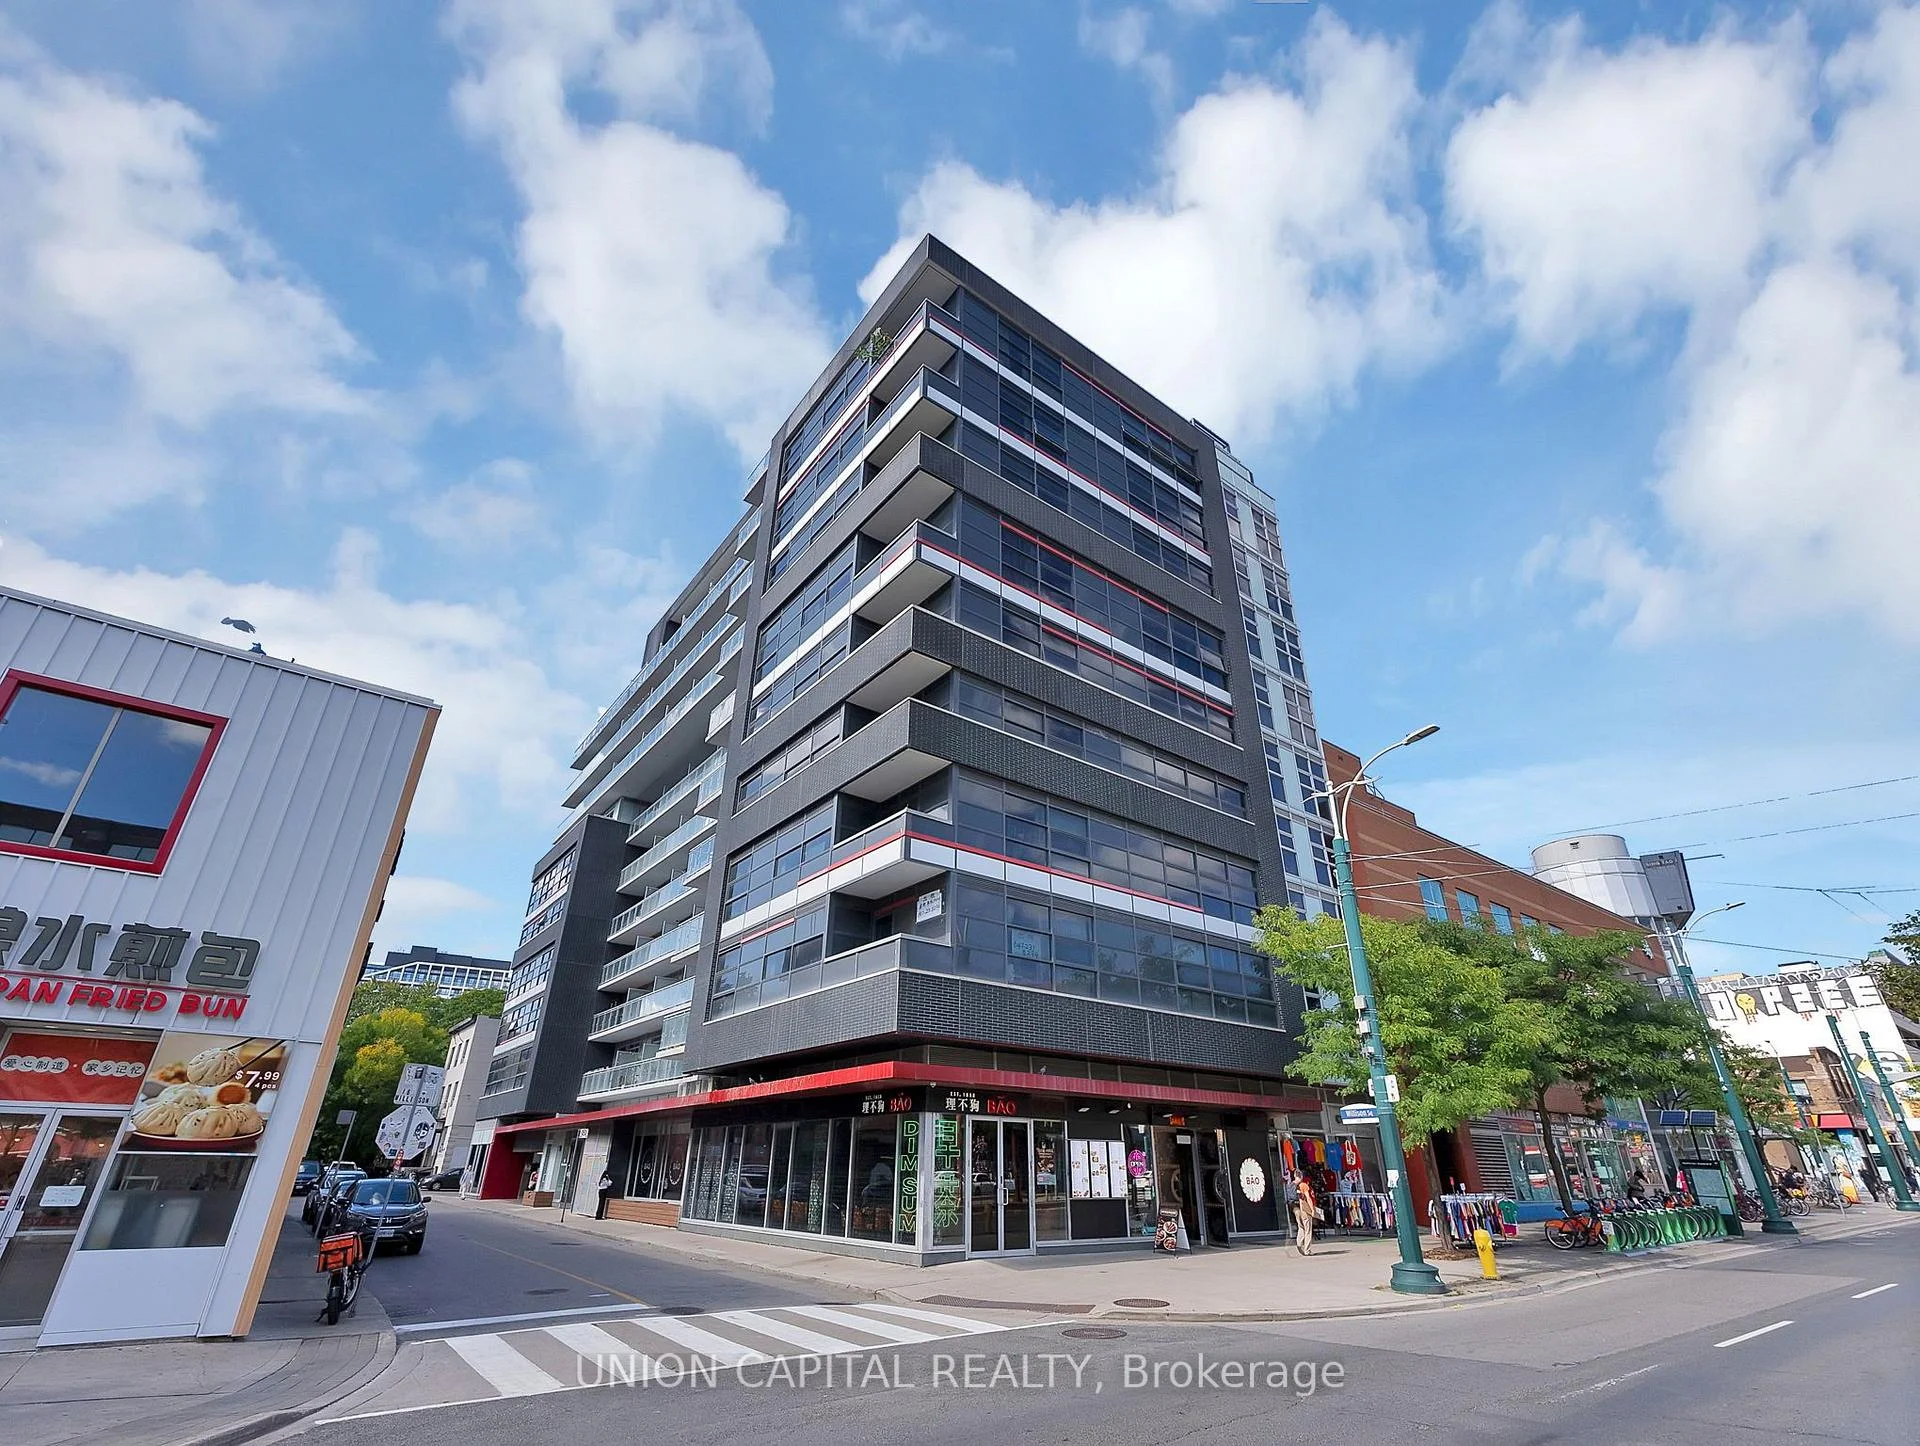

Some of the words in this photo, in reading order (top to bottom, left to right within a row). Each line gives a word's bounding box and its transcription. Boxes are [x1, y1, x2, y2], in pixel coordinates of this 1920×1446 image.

[67, 983, 168, 1012] FRIED
[178, 994, 249, 1021] BUN
[235, 1070, 280, 1089] $7.99
[902, 1120, 919, 1172] DIM
[899, 1176, 919, 1232] SUM
